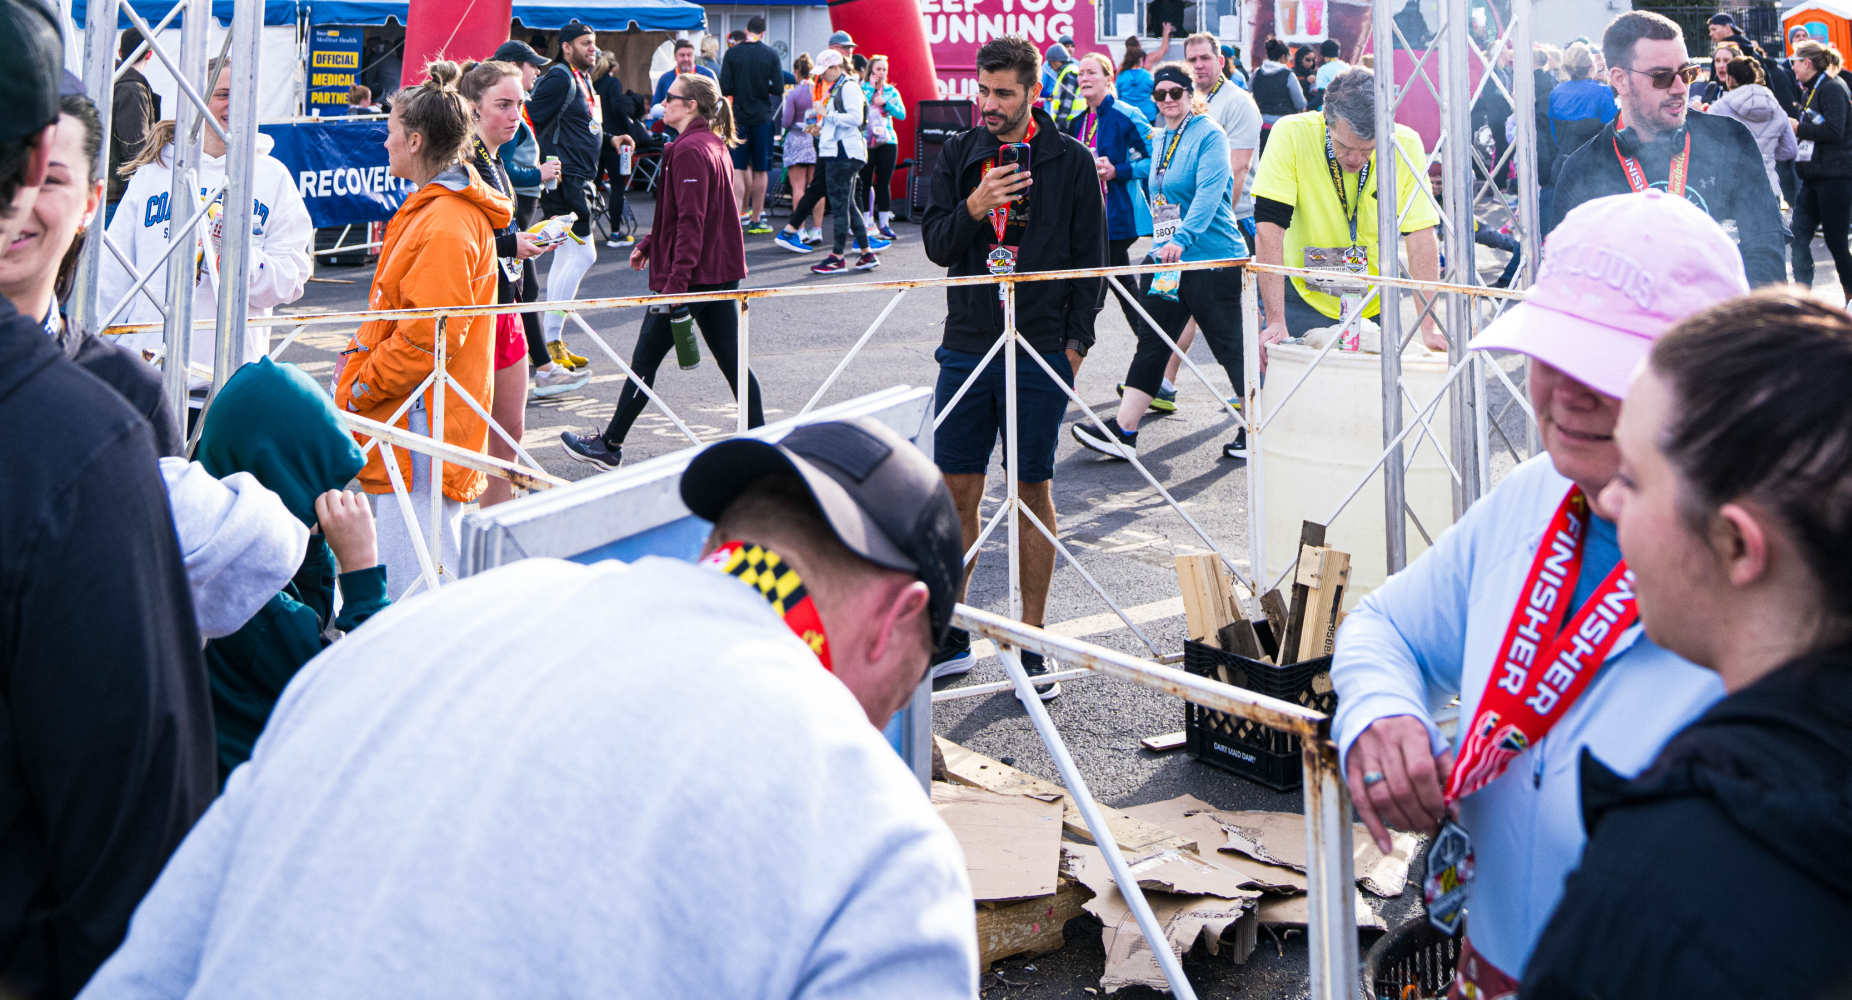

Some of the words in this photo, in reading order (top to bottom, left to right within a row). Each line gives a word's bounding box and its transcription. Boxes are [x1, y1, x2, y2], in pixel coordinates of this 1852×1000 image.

[923, 13, 1074, 44] UNNING
[316, 53, 355, 65] OFFICIAL
[312, 73, 355, 87] MEDICAL
[311, 91, 351, 105] PARTNE
[1624, 157, 1645, 193] INISH
[1497, 510, 1583, 696] FINISHER
[1524, 569, 1637, 717] NISHER
[1213, 741, 1229, 754] DAIRY
[1228, 747, 1242, 759] MAID
[1241, 752, 1257, 764] DAIRY
